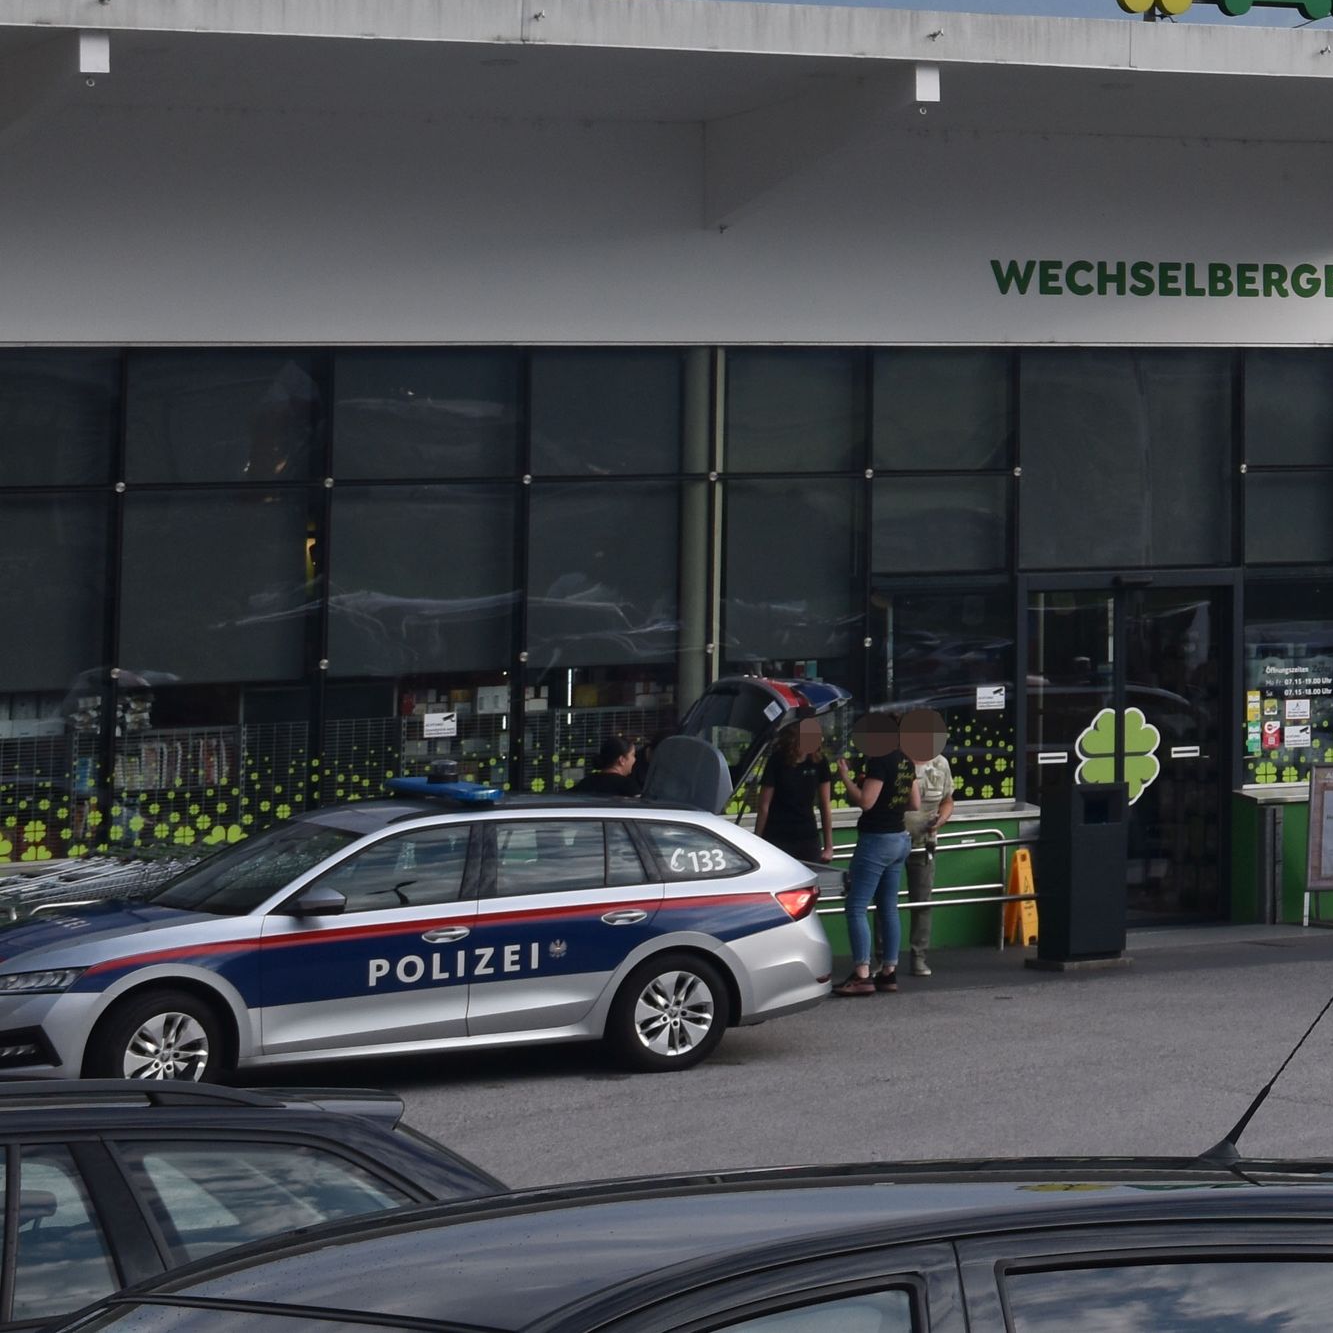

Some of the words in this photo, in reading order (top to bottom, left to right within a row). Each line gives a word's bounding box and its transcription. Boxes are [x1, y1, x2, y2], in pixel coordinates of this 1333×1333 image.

[1265, 666, 1309, 675] Öffnungszeiten
[1322, 687, 1333, 695] Uhr
[688, 848, 727, 873] 133
[368, 942, 540, 987] POLIZEI
